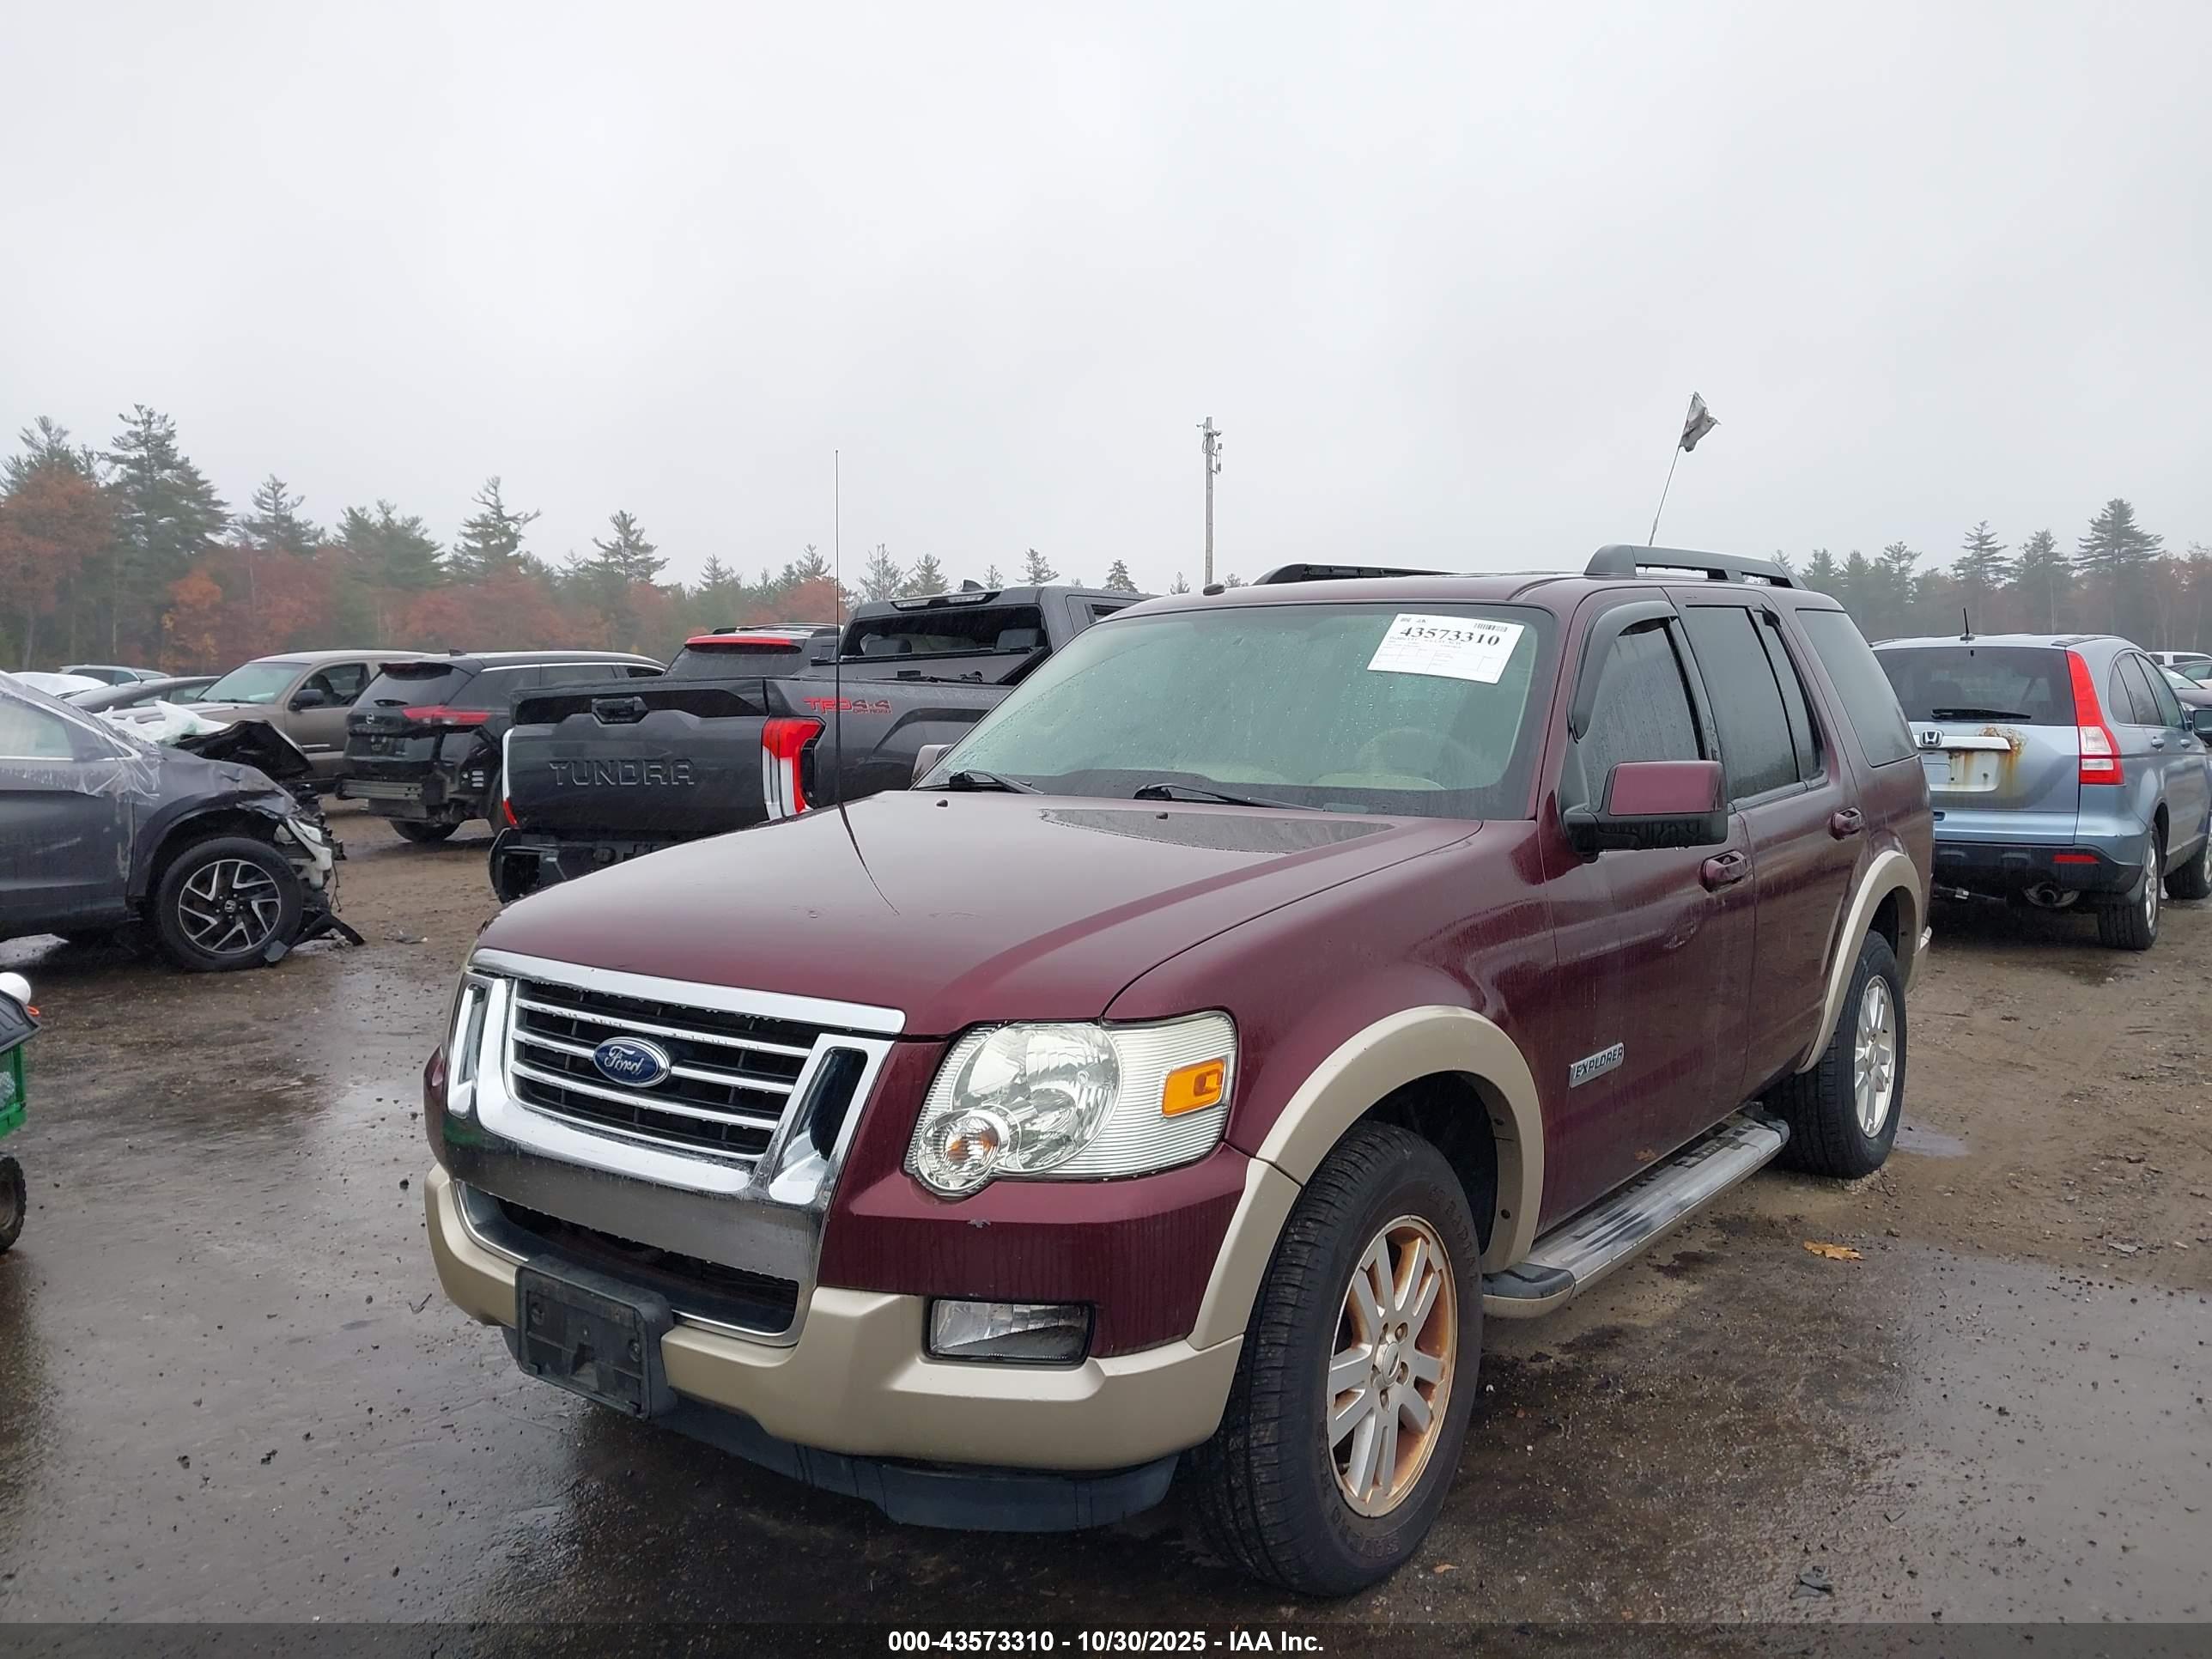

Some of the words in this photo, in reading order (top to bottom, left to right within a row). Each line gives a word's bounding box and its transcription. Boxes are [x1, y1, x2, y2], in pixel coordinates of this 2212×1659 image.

[1400, 627, 1500, 646] 43573310
[549, 760, 695, 786] TUNDRA
[604, 1045, 645, 1075] Ford
[1575, 1047, 1623, 1079] EXPLORER
